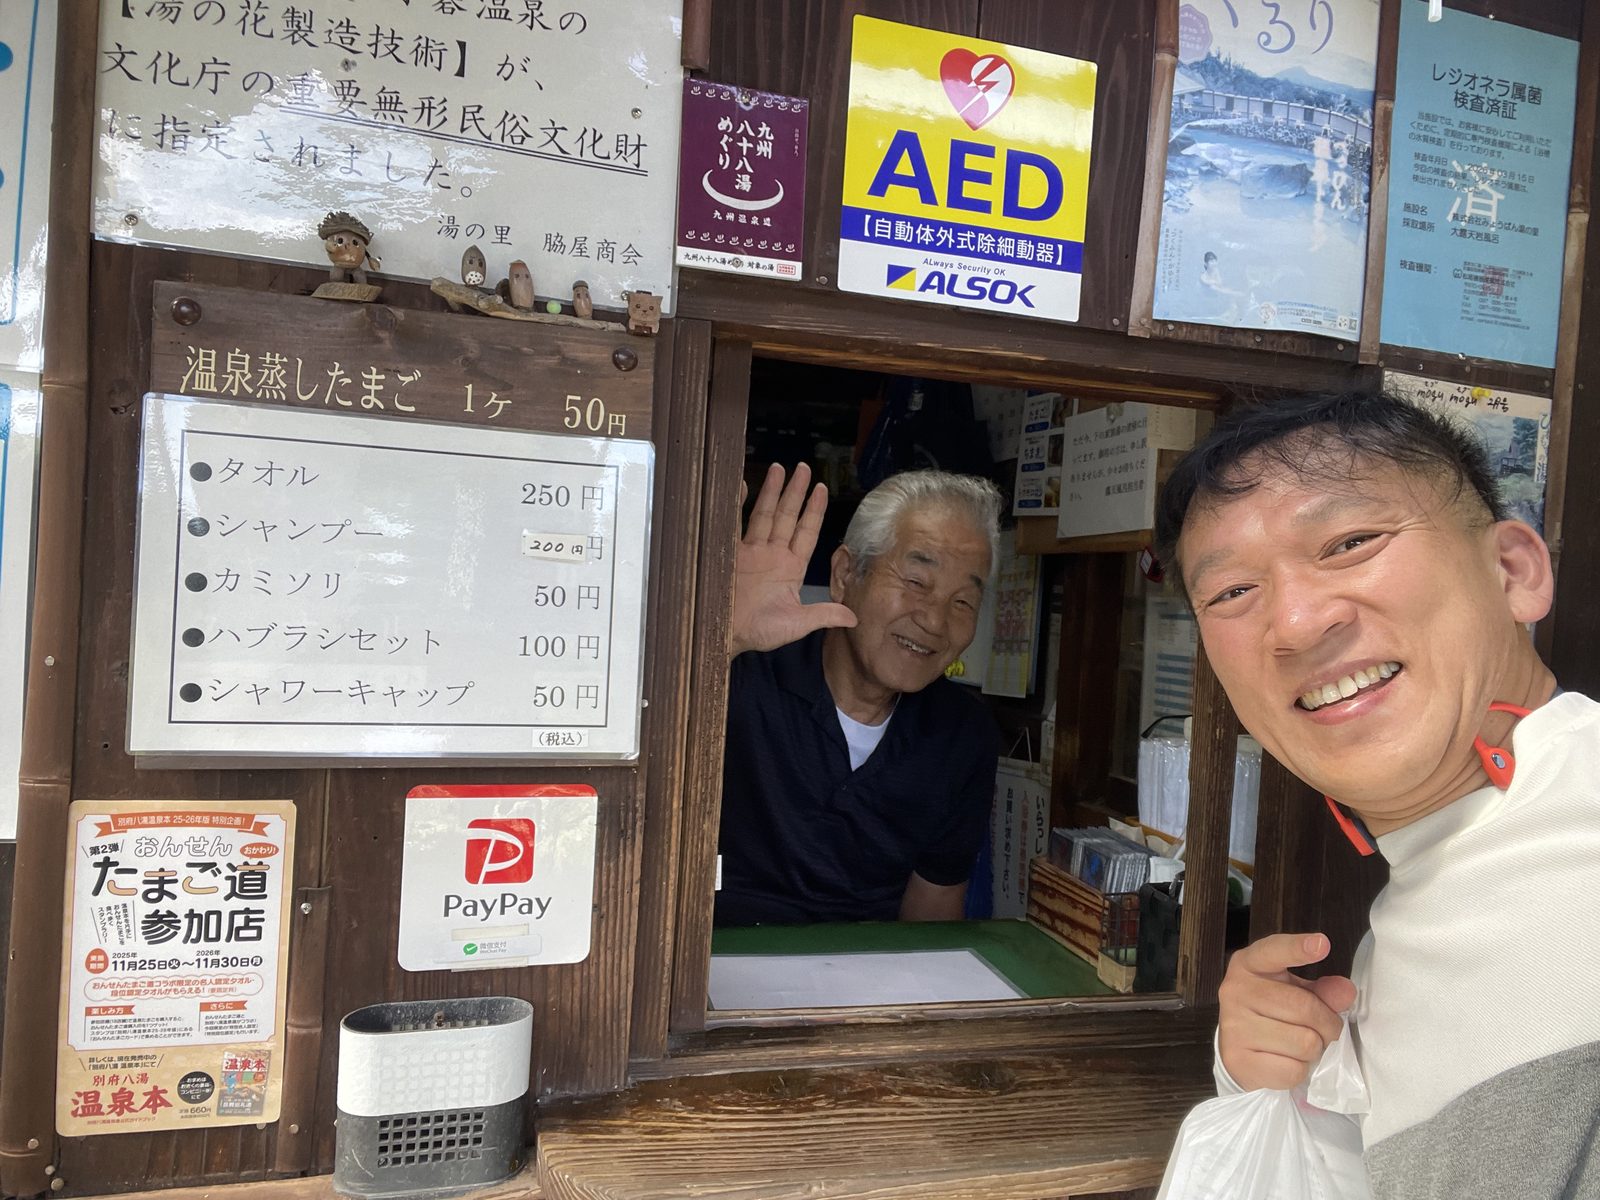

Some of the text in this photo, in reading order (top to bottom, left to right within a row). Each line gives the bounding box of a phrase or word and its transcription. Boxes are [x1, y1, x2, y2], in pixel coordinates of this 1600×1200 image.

[1432, 63, 1543, 105] レジオネラ属菌
[101, 42, 649, 169] 文化庁の重要無形民俗文化財
[1453, 89, 1518, 120] 検査済証
[107, 109, 473, 198] に指定されました。
[717, 115, 734, 170] めぐり
[735, 119, 756, 193] 八十八湯
[755, 121, 775, 160] 九州
[867, 129, 1065, 223] AED
[712, 209, 772, 227] 九州温泉道
[436, 215, 645, 267] 湯の里 脇屋商会
[861, 213, 1064, 266] 【自動体外式除細動器】
[957, 262, 991, 276] Security
[994, 267, 1006, 277] OK
[918, 270, 1037, 309] ALSOK
[179, 344, 421, 412] 温泉蒸したまご
[564, 395, 627, 436] 50円
[218, 456, 320, 487] タオル
[214, 513, 384, 544] シャンプー
[211, 566, 343, 599] カミソリ
[207, 621, 443, 655] ハブラシセット
[207, 678, 476, 709] シャワーキャップ
[172, 815, 210, 826] 25-26年版
[89, 842, 120, 857] 第2弾
[134, 836, 233, 858] おんせん
[91, 855, 270, 904] たまご道
[444, 893, 552, 921] PayPay
[141, 907, 265, 945] 参加店
[112, 951, 138, 960] 2025年
[196, 949, 221, 957] 2026年
[91, 1006, 125, 1015] 楽しみ方
[210, 1002, 234, 1010] さらに
[93, 1073, 149, 1087] 別府八湯
[225, 1058, 266, 1071] 温泉本
[71, 1084, 174, 1119] 温泉本
